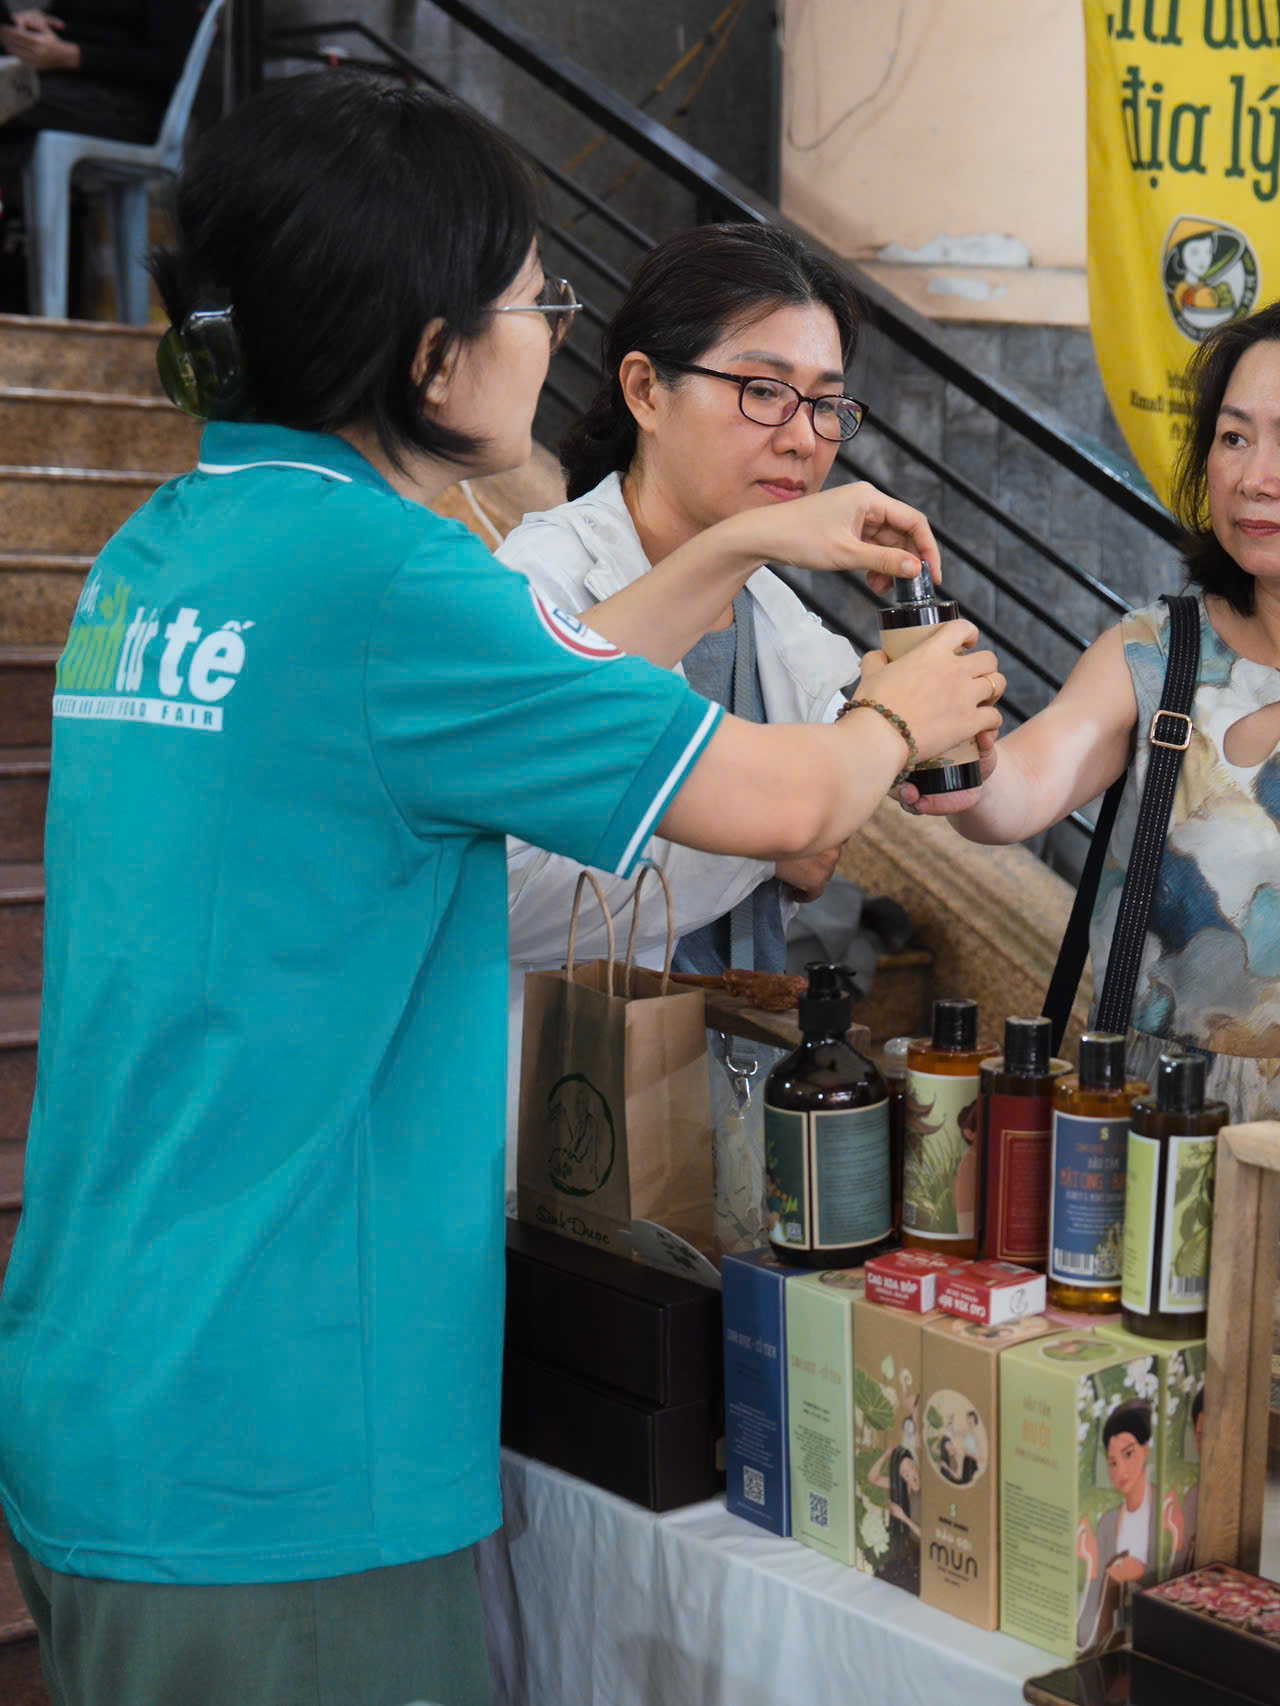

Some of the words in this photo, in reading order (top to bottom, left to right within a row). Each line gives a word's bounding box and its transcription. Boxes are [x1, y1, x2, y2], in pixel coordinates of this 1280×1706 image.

[1121, 66, 1211, 189] địa
[159, 607, 256, 703] tế
[162, 704, 214, 726] FAIR
[929, 1540, 978, 1579] mun
